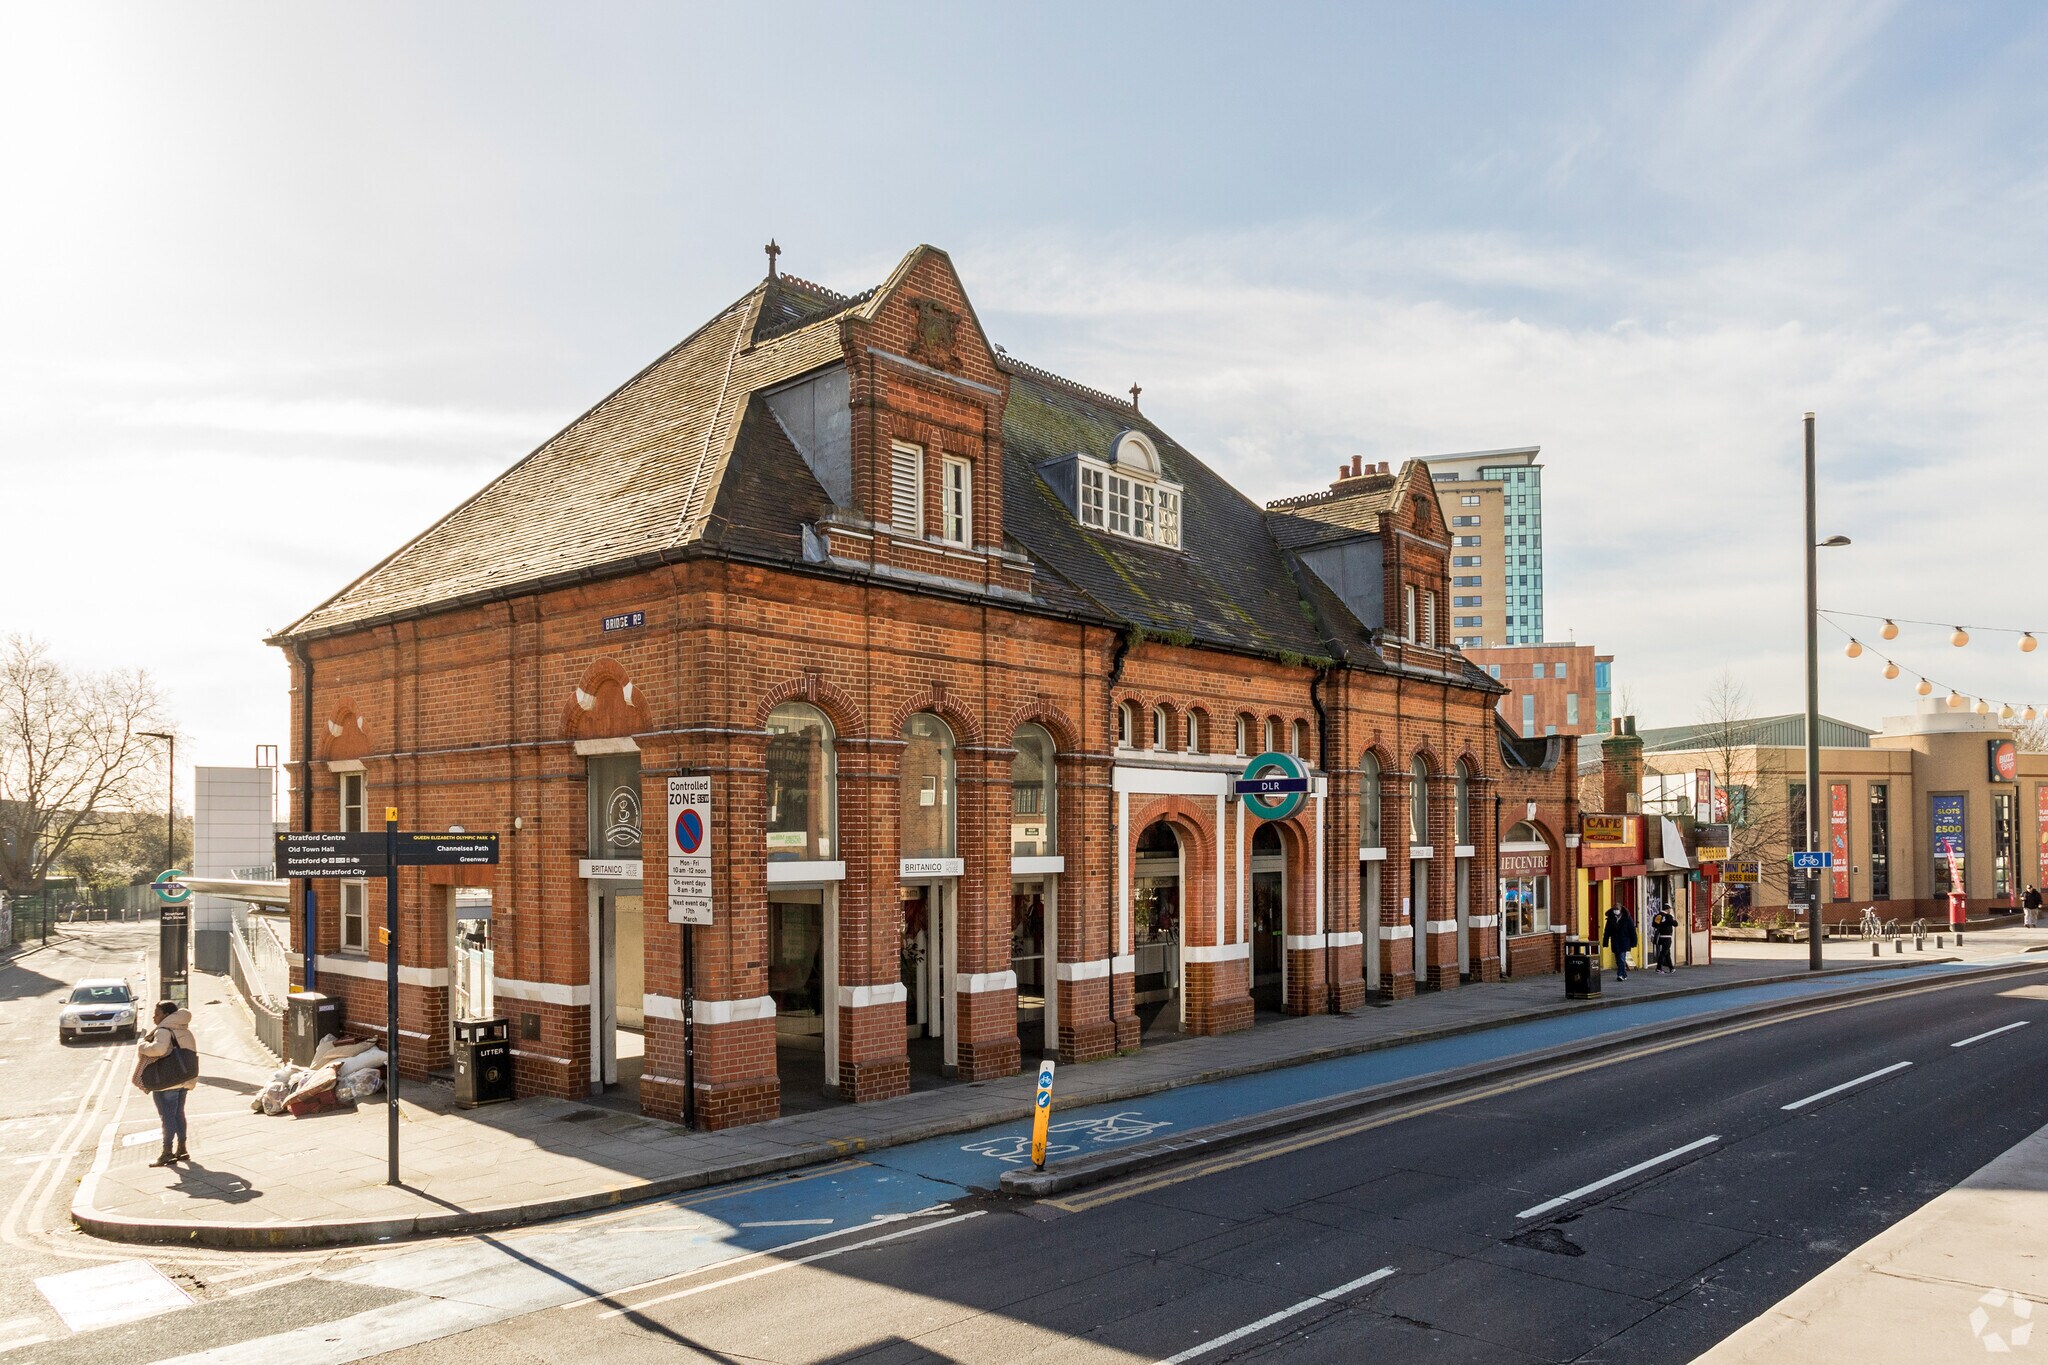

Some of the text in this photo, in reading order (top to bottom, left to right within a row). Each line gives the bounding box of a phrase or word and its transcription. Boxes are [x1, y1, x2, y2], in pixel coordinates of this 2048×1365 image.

[605, 614, 642, 630] BRIDGE RD
[670, 781, 708, 790] Controlled
[670, 794, 696, 804] ZONE
[1586, 818, 1622, 828] CAFE
[1725, 864, 1758, 873] MINI CABS
[480, 1048, 503, 1056] LITTER
